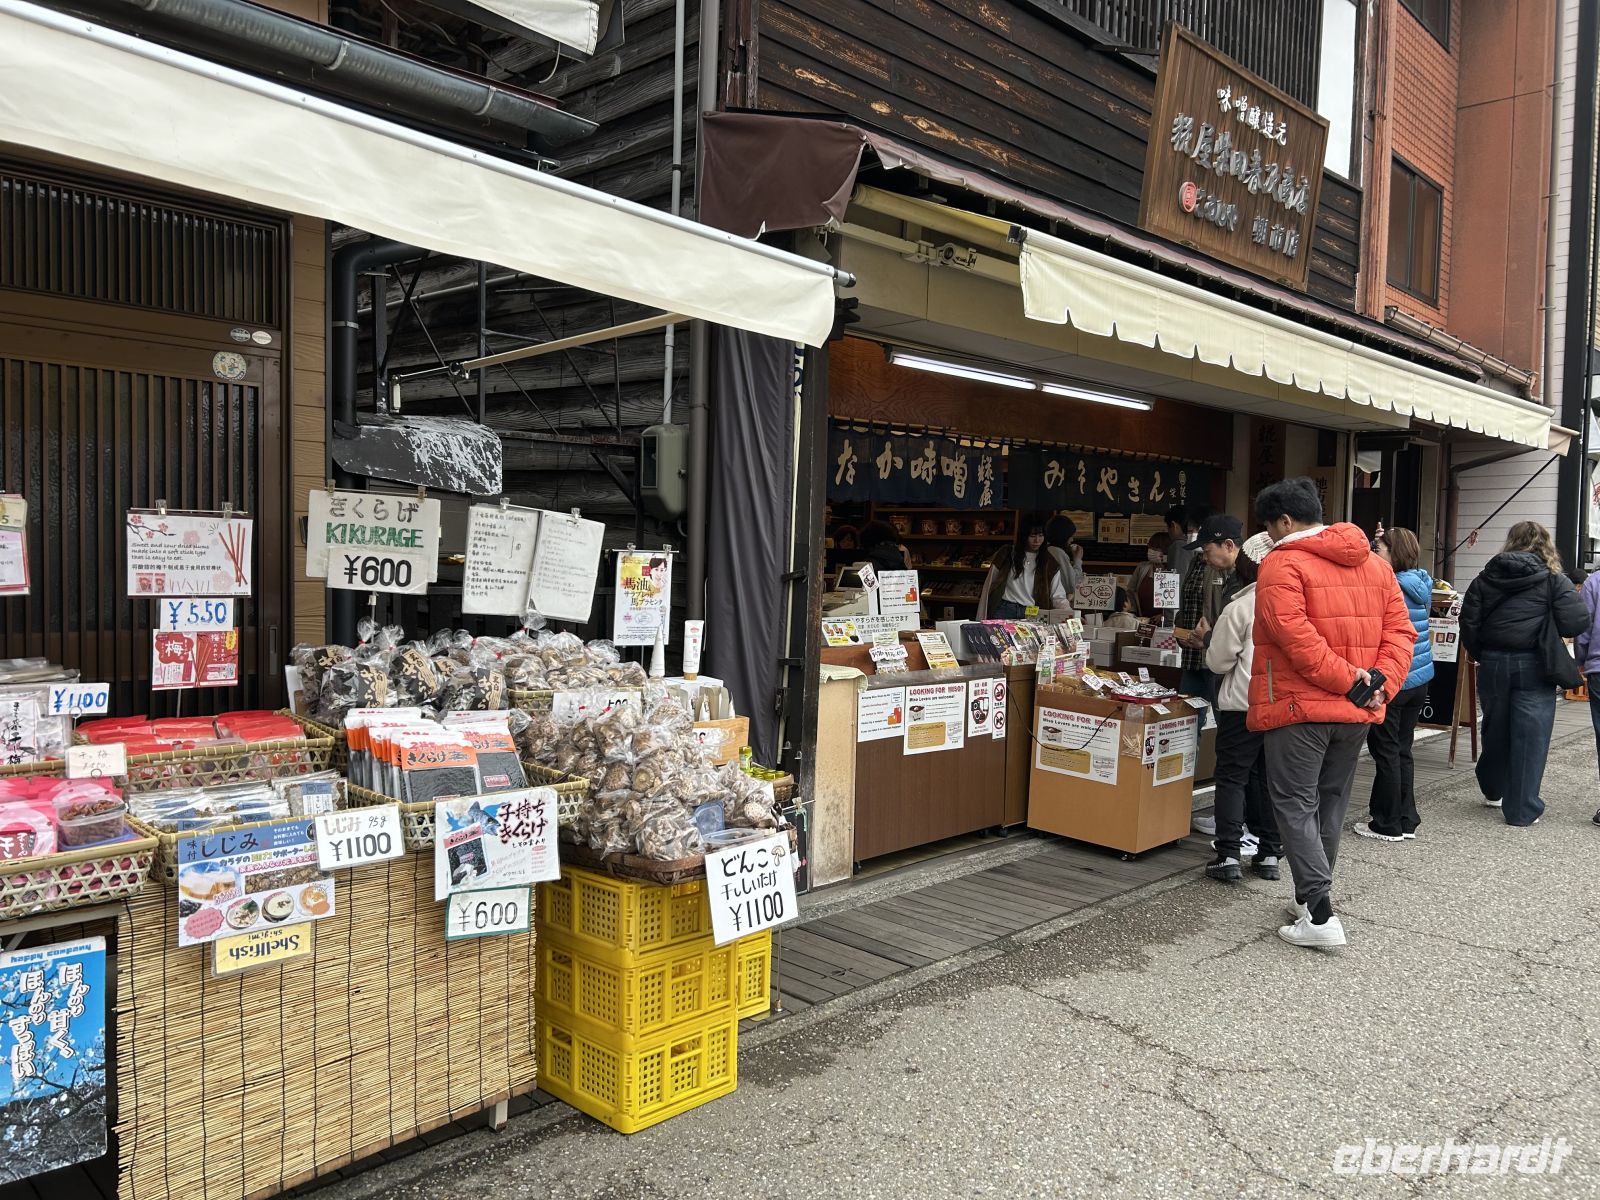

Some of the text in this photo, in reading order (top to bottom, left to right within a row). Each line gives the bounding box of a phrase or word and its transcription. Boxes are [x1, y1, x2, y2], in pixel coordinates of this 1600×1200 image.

[1216, 84, 1288, 147] 味噌醸造元
[329, 497, 420, 523] きくらげ
[325, 522, 424, 549] KIKURAGE
[343, 555, 412, 588] ¥600
[169, 600, 227, 630] ¥550
[165, 640, 184, 657] 梅
[54, 688, 107, 712] ¥1100
[909, 687, 935, 696] LOOKING
[1043, 710, 1075, 721] LOOKING
[1076, 716, 1091, 725] FOR
[1159, 721, 1177, 730] LOOKING
[1177, 719, 1185, 727] FOR
[499, 798, 545, 822] 子持ち
[324, 816, 362, 836] しじみ
[500, 818, 549, 845] きくらげ
[187, 840, 197, 860] 味付
[201, 832, 259, 858] しじみ
[329, 832, 392, 862] ¥1100
[720, 848, 769, 877] どんこ
[457, 901, 518, 932] ¥600
[729, 891, 784, 931] ¥1100
[10, 943, 92, 963] happy company
[229, 934, 300, 960] Shellfish
